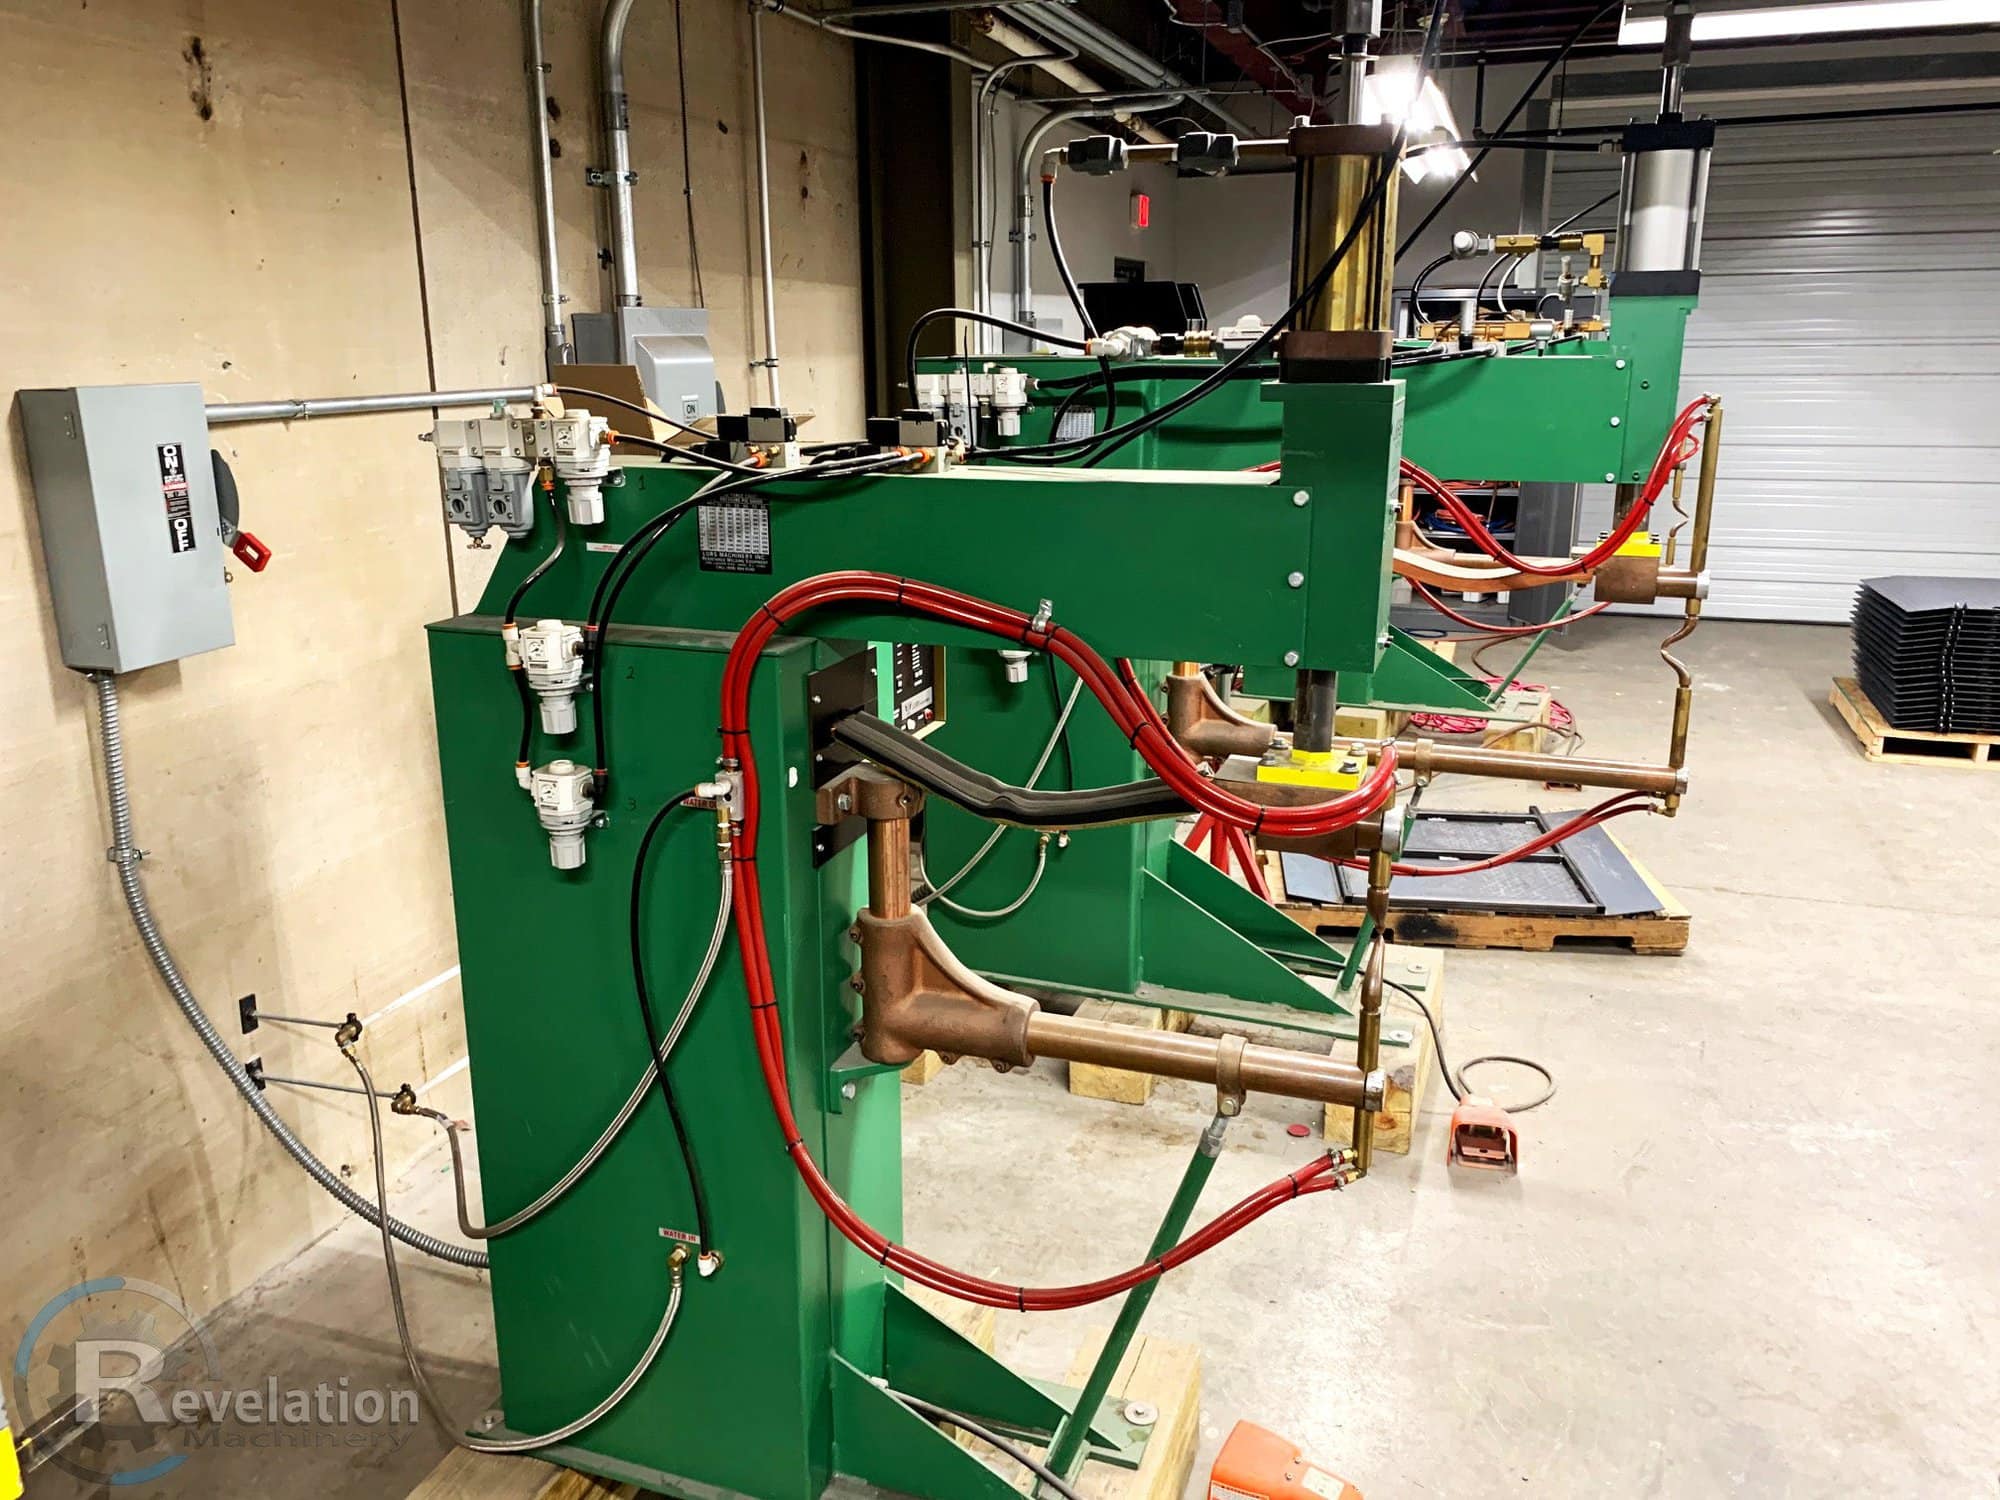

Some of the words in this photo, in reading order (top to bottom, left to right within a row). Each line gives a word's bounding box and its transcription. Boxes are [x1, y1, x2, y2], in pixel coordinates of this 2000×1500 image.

[686, 403, 696, 414] ON
[163, 445, 179, 469] ON
[174, 518, 189, 552] OFF
[663, 1230, 687, 1240] WATER
